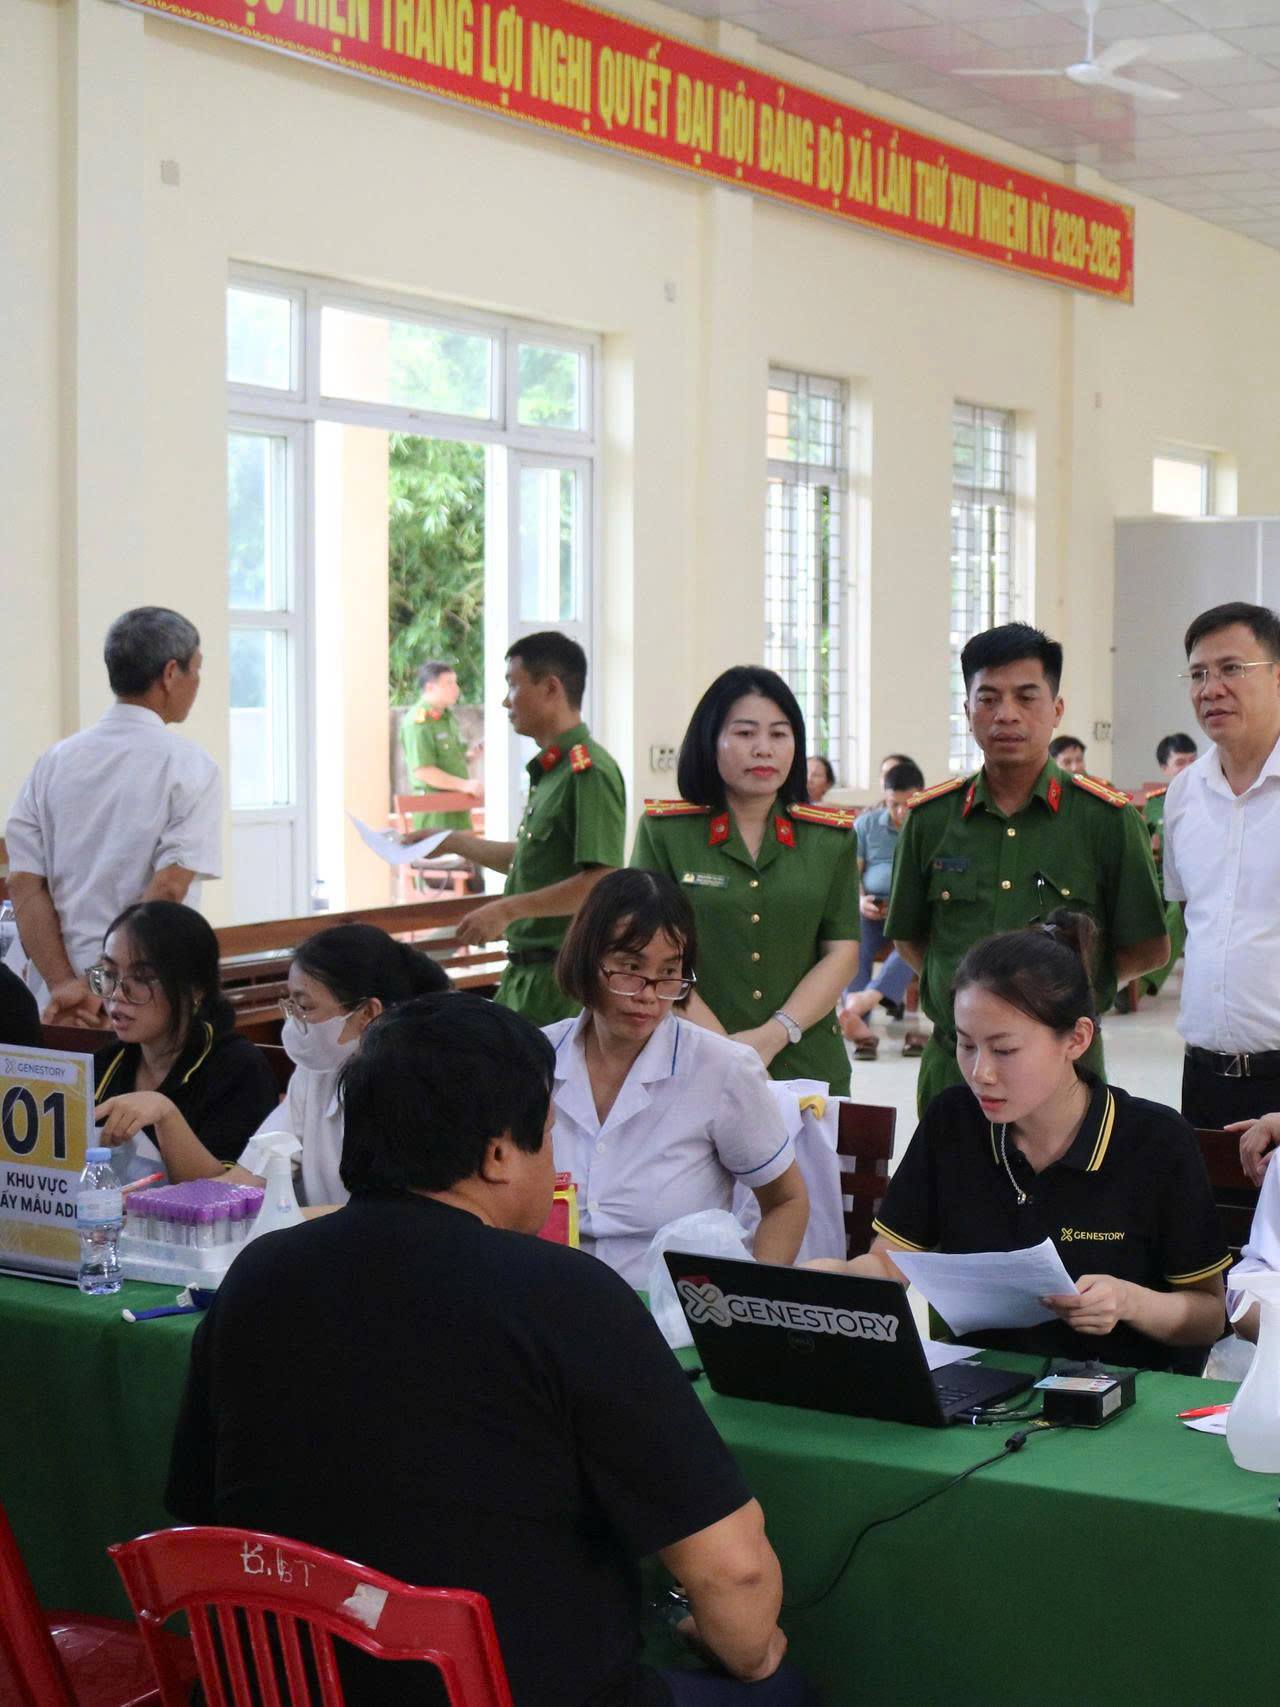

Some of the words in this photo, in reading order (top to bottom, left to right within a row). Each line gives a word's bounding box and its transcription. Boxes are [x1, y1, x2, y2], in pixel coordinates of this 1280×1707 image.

[482, 4, 523, 105] LỢI
[531, 21, 592, 131] NGHỊ
[599, 41, 672, 138] QUYẾT
[676, 73, 714, 164] ĐẠI
[719, 80, 755, 178] HỘI
[759, 85, 814, 186] ĐẢNG
[818, 116, 844, 209] BỘ
[848, 128, 873, 206] XÃ
[877, 129, 912, 217] LẦN
[915, 155, 949, 229] THỨ
[950, 172, 977, 239] XIV
[979, 179, 1029, 262] NHIỆM
[1052, 208, 1121, 281] 2020-2025
[17, 1063, 66, 1078] GENESTORY
[2, 1086, 66, 1159] 01
[7, 1171, 34, 1189] KHU
[38, 1176, 68, 1196] VỰC
[0, 1189, 18, 1209] ẤY
[21, 1193, 52, 1215] MẪU
[55, 1202, 78, 1219] AD
[1073, 1231, 1125, 1241] GENESTORY
[728, 1299, 893, 1338] GENESTORY
